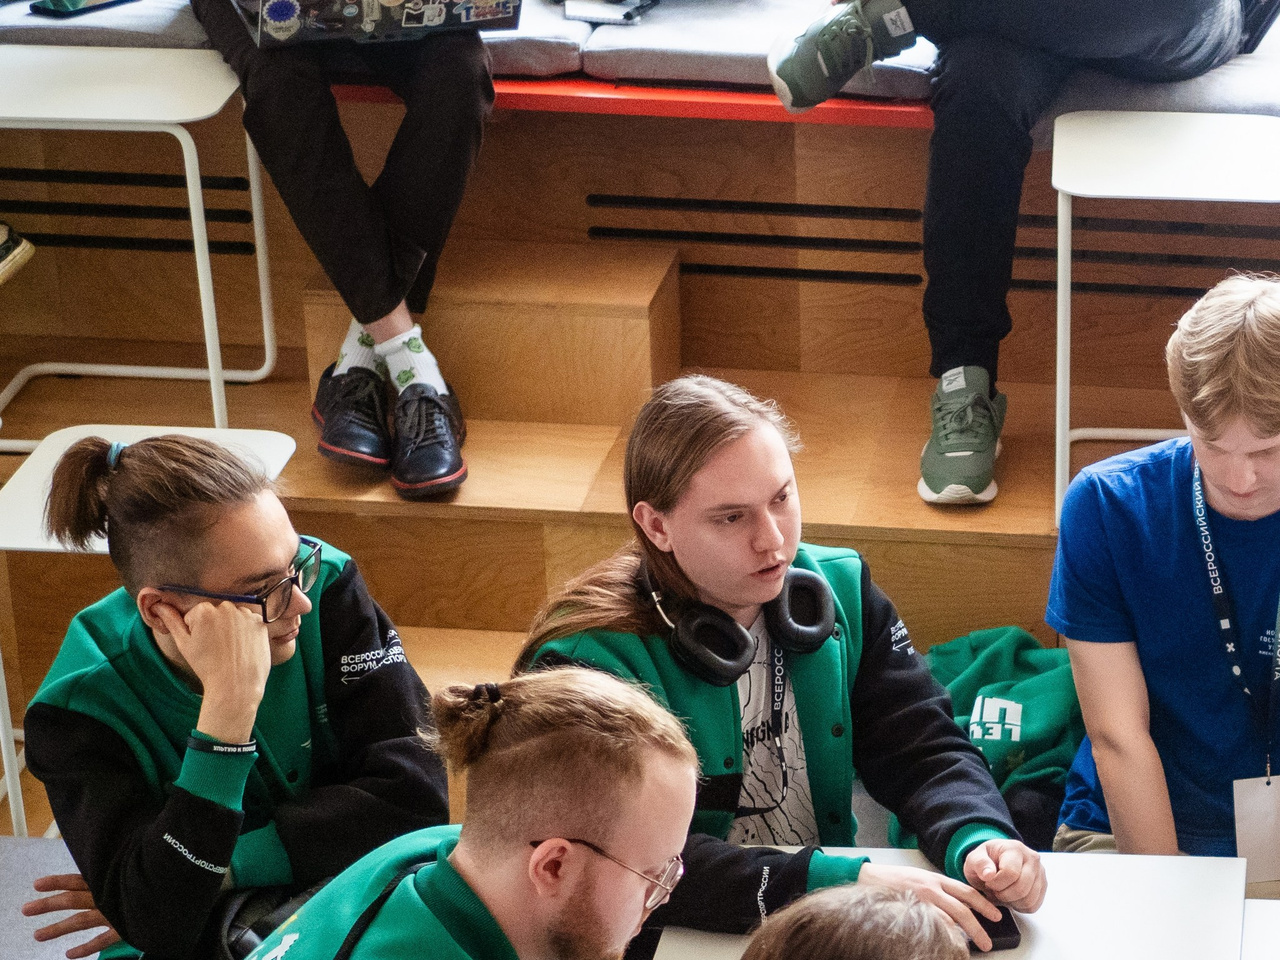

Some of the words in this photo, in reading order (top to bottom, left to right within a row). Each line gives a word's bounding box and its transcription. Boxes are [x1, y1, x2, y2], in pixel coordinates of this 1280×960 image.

[1193, 481, 1224, 595] ВСЕРОССИЙСКИЙ
[340, 660, 378, 673] ФОРУМ
[773, 648, 784, 711] ВСЕРОСС
